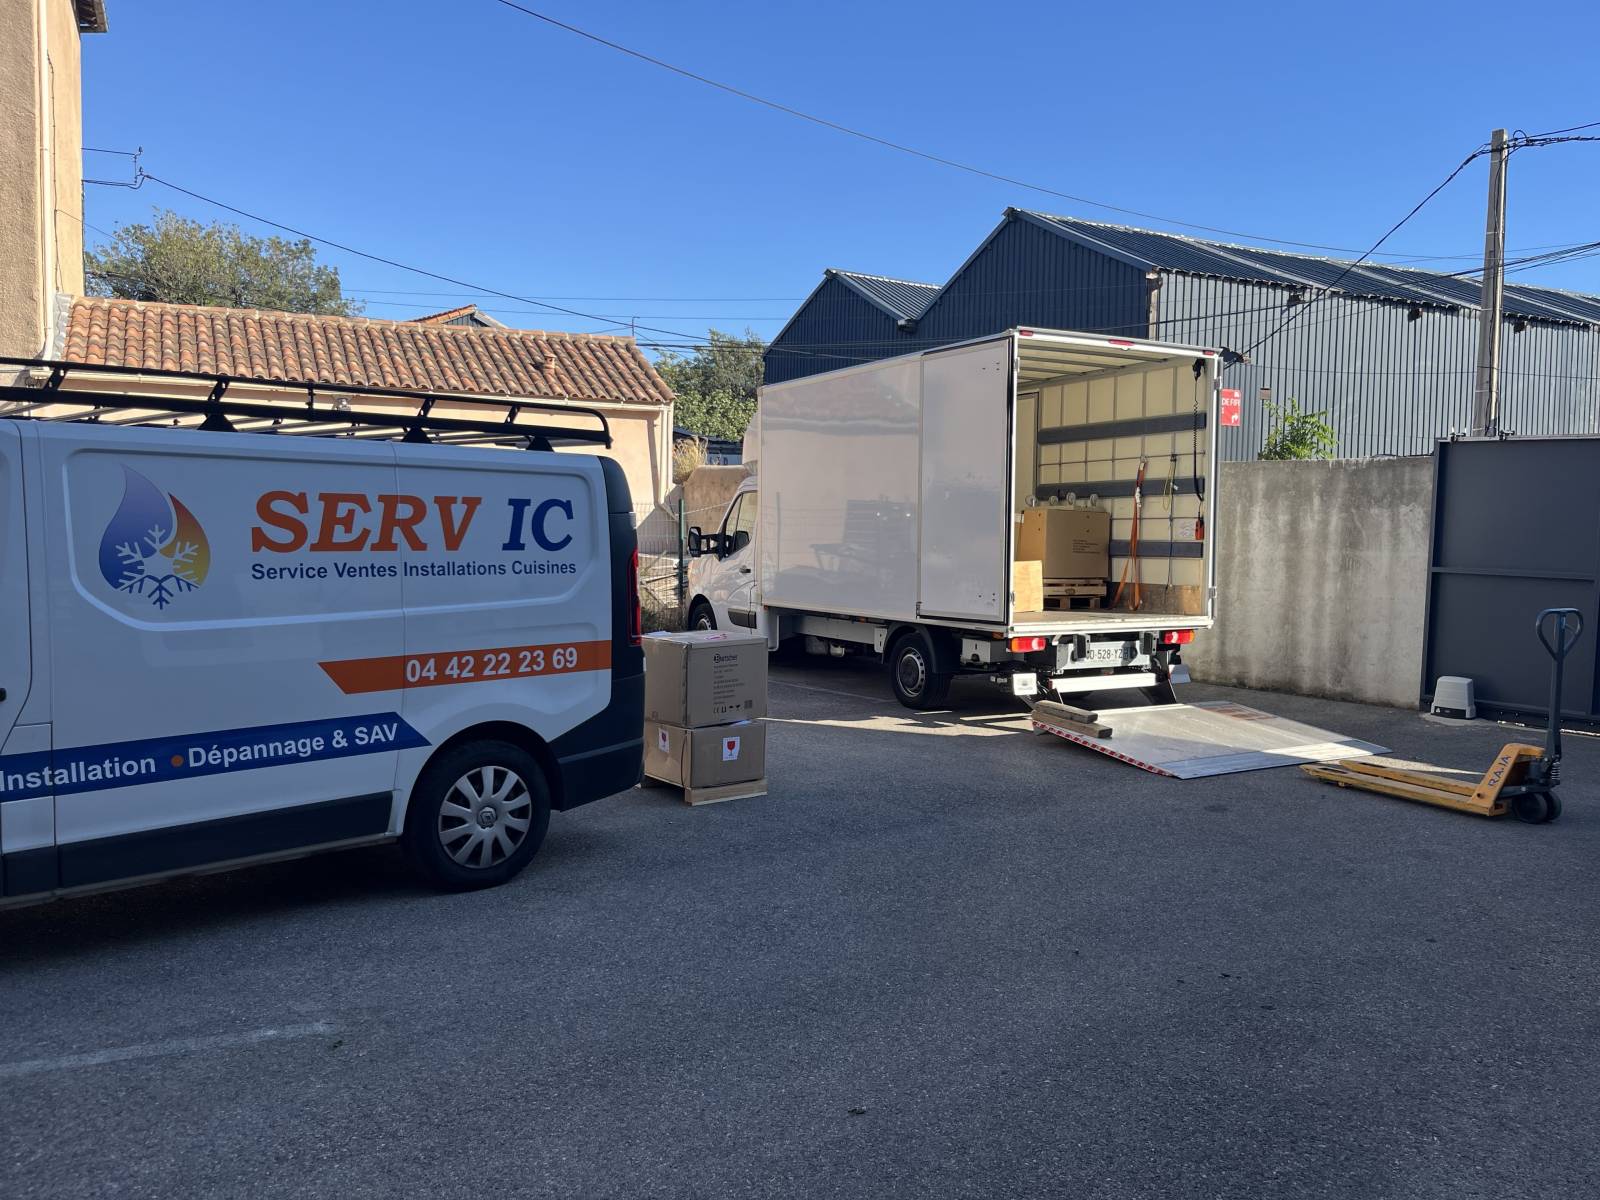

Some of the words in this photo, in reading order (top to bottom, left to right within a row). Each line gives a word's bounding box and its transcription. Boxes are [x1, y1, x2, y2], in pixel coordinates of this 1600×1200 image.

[251, 490, 482, 553] SERV
[501, 498, 574, 552] IC
[251, 563, 328, 580] Service
[334, 561, 398, 578] Ventes
[403, 560, 507, 577] Installations
[511, 560, 577, 575] Cuisines
[405, 657, 437, 683] 04
[444, 655, 475, 679] 42
[482, 653, 511, 676] 22
[518, 650, 545, 673] 23
[552, 647, 578, 670] 69
[0, 757, 156, 792] Installation
[187, 735, 325, 768] Dépannage
[332, 729, 349, 748] &
[354, 722, 398, 746] SAV
[1487, 755, 1512, 787] RAJA
